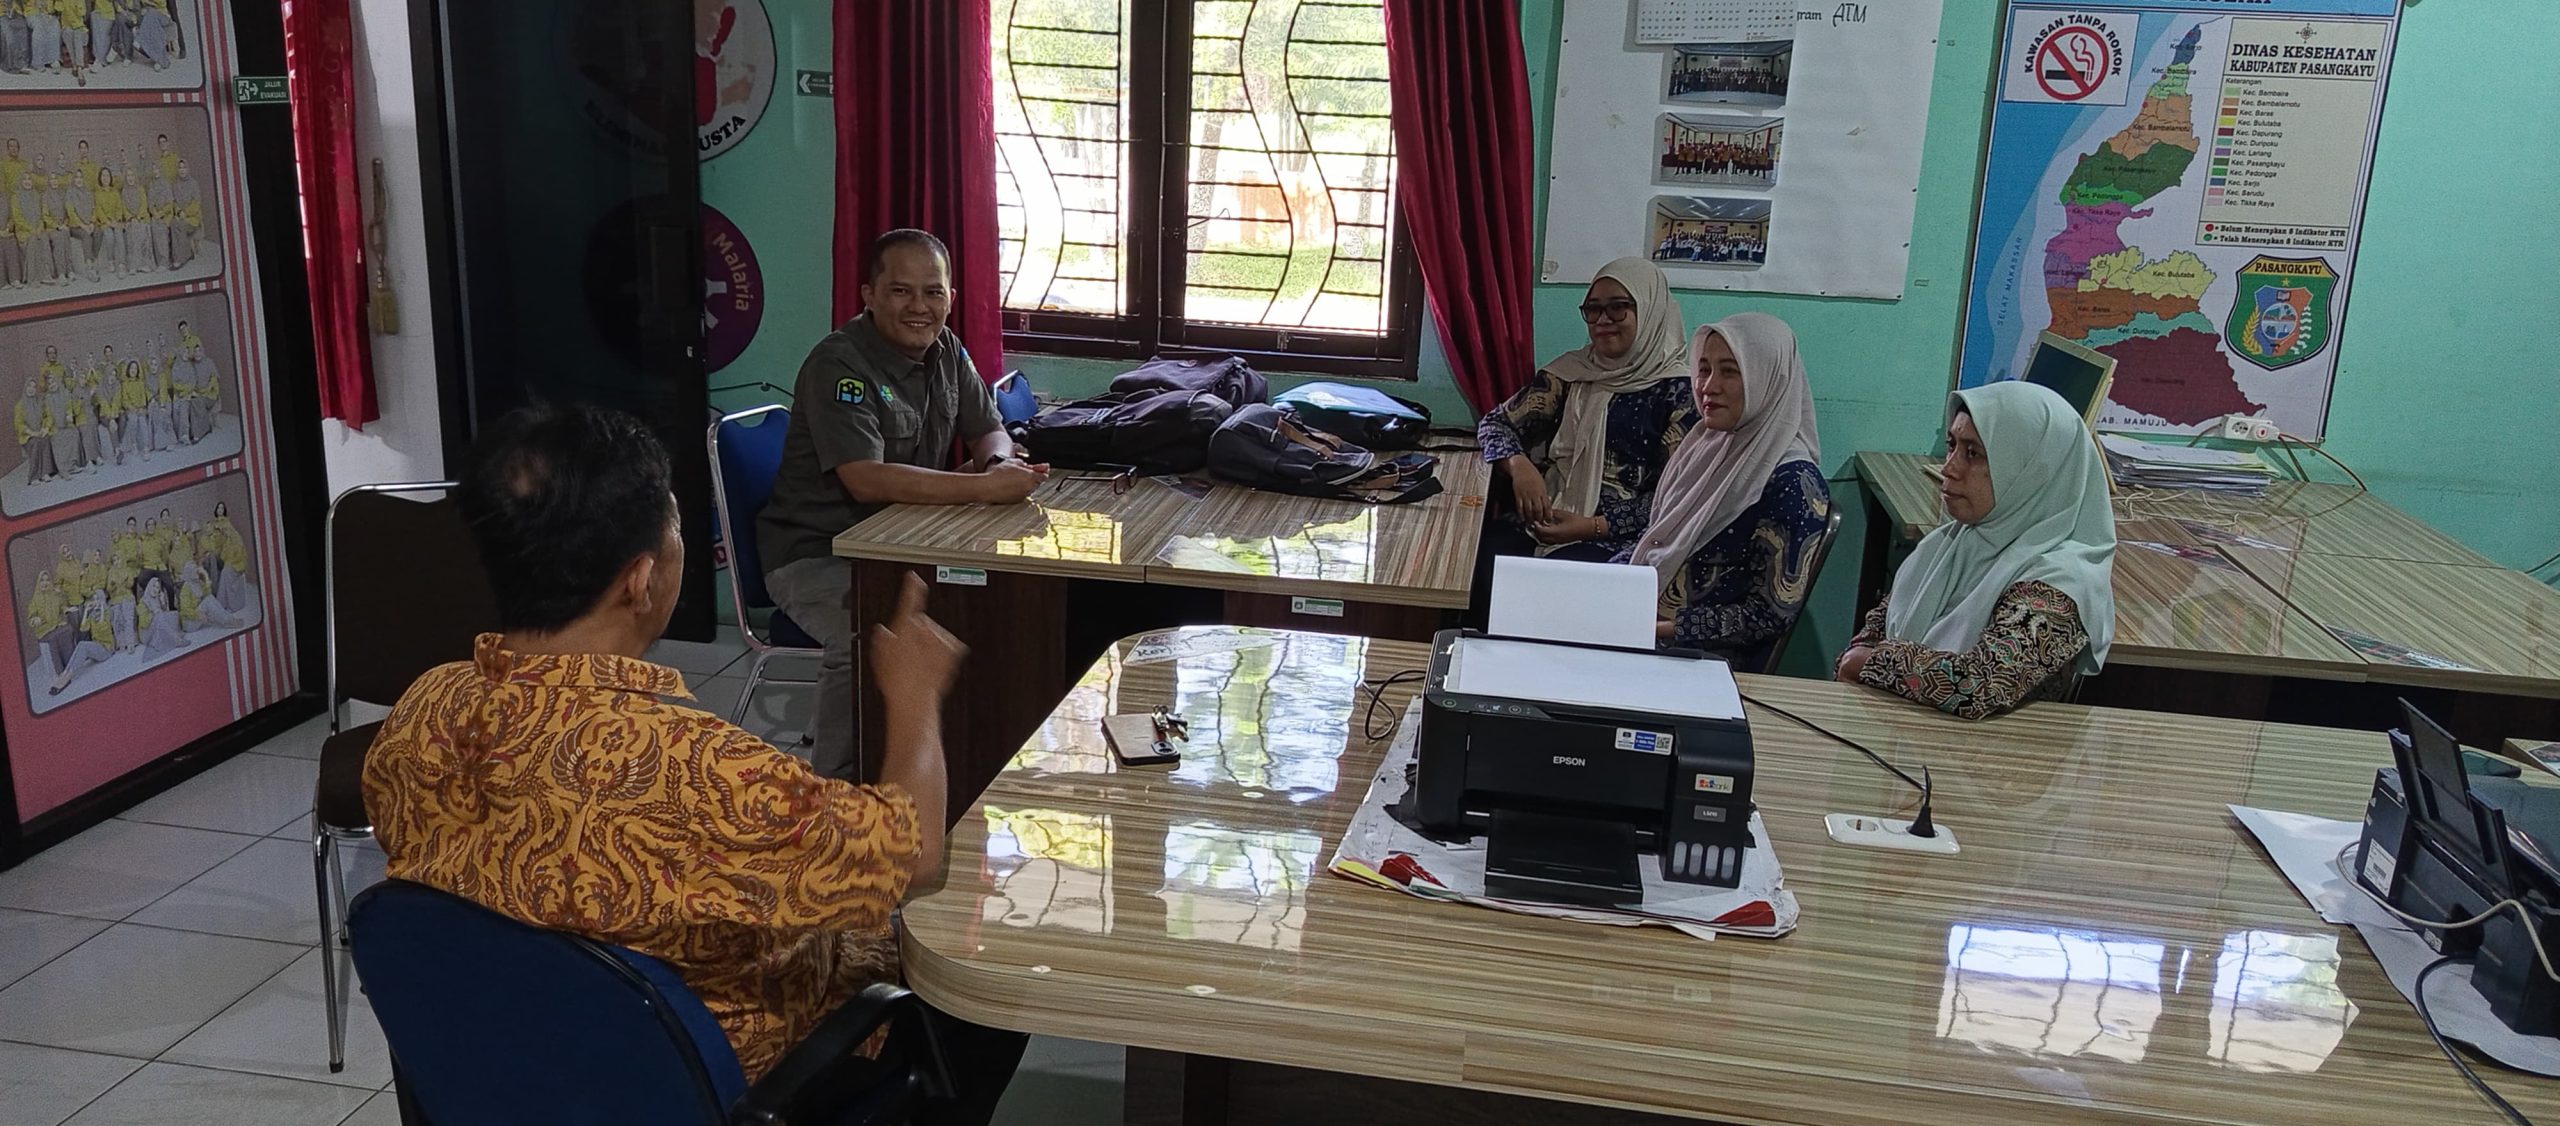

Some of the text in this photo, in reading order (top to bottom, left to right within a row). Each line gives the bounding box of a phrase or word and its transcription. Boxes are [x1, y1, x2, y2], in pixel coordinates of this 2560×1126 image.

[1796, 11, 1822, 21] ram
[1832, 3, 1867, 28] ATM
[2024, 14, 2123, 76] KAWASAN TANPA ROKOK
[2231, 43, 2377, 62] DINAS KESEHATAN
[2230, 60, 2376, 77] KABUPATEN PASANGKAYU
[700, 115, 746, 151] USTA
[2220, 225, 2243, 233] Belum
[2244, 225, 2287, 236] Menerapkan
[2295, 227, 2329, 237] Indikator
[2330, 229, 2346, 237] KTR
[2220, 235, 2240, 243] Telah
[2241, 236, 2284, 246] Menerapkan
[2292, 237, 2327, 247] Indikator
[2327, 239, 2344, 247] KTR
[712, 232, 755, 312] Malaria
[2254, 262, 2322, 275] PASANGKAYU
[1997, 237, 2022, 327] SELAT MAKASSAR
[2097, 416, 2168, 427] AB. MAMUJU
[1553, 755, 1586, 767] EPSON
